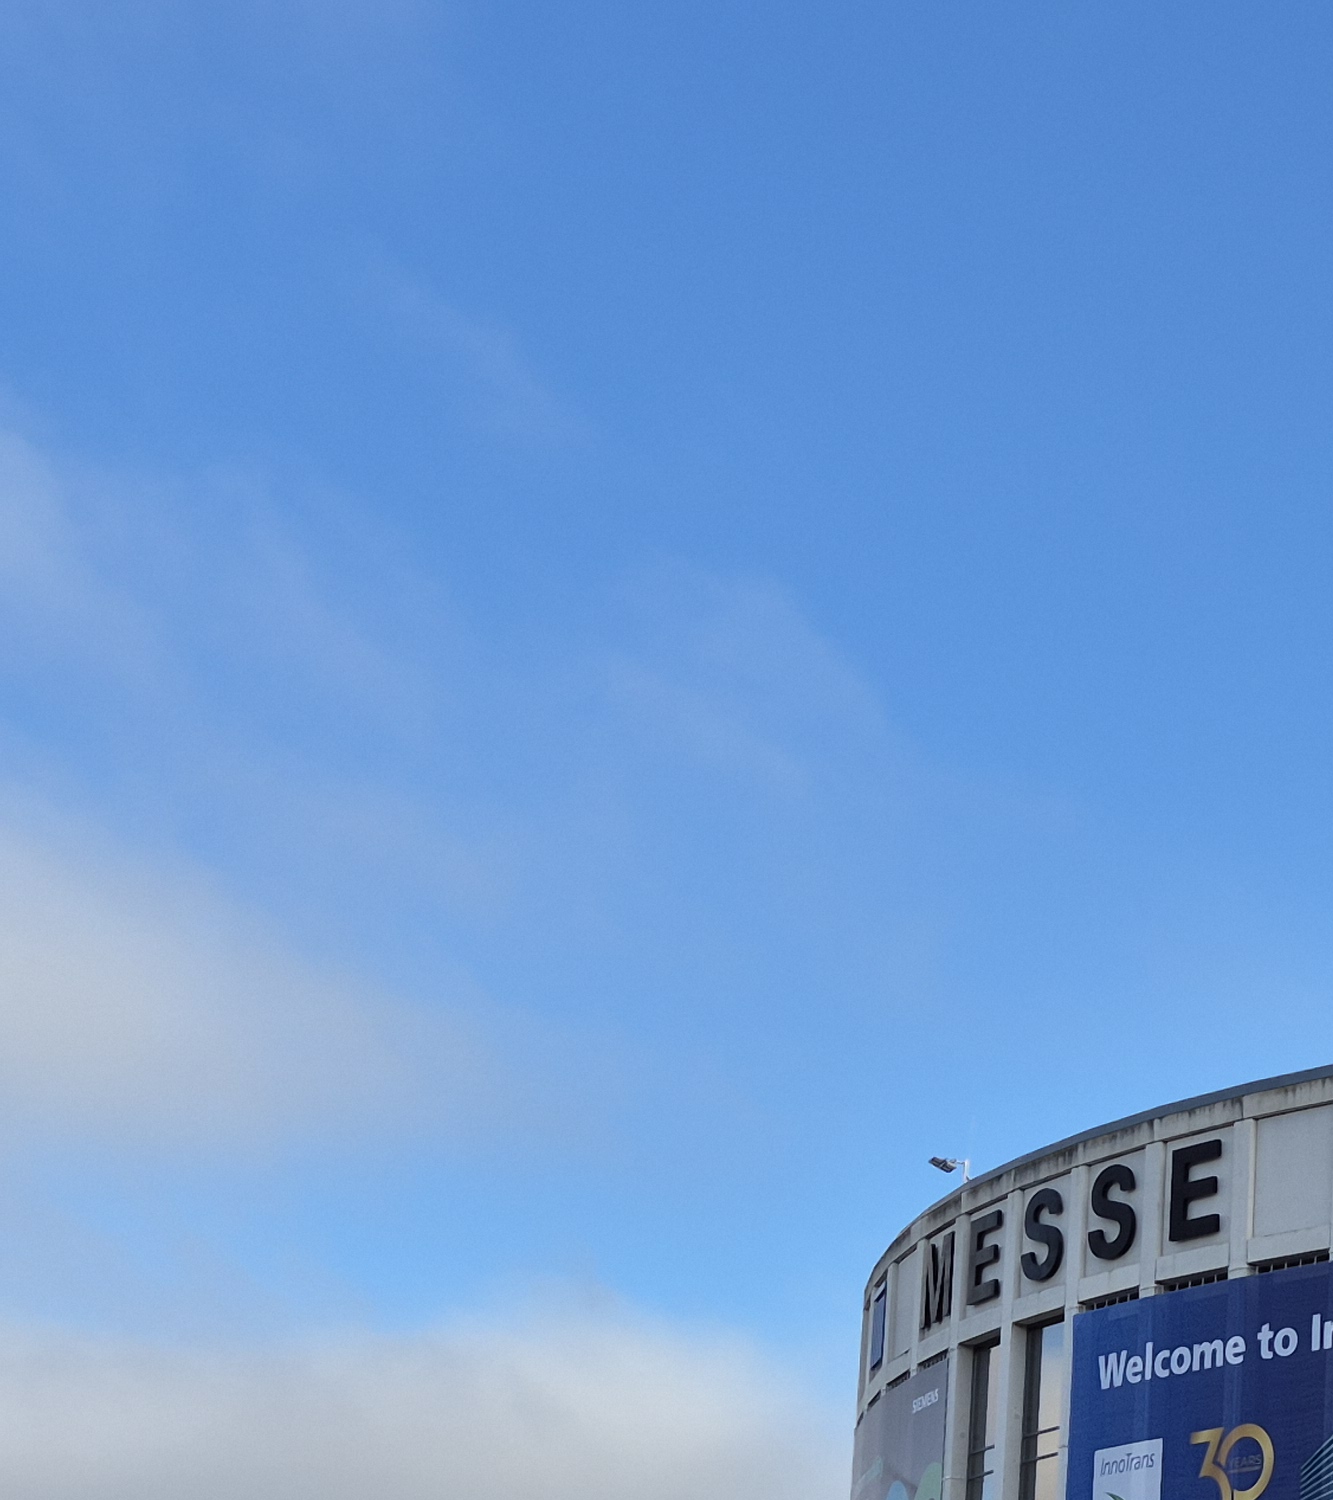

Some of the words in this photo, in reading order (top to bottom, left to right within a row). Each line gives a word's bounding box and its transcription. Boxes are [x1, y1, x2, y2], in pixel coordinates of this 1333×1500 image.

[919, 1138, 1221, 1329] MESSE
[1098, 1337, 1247, 1390] Welcome
[1258, 1322, 1298, 1360] to
[912, 1388, 939, 1414] SIEMENS
[1100, 1452, 1155, 1477] InnoTrans
[1229, 1454, 1262, 1467] YEARS
